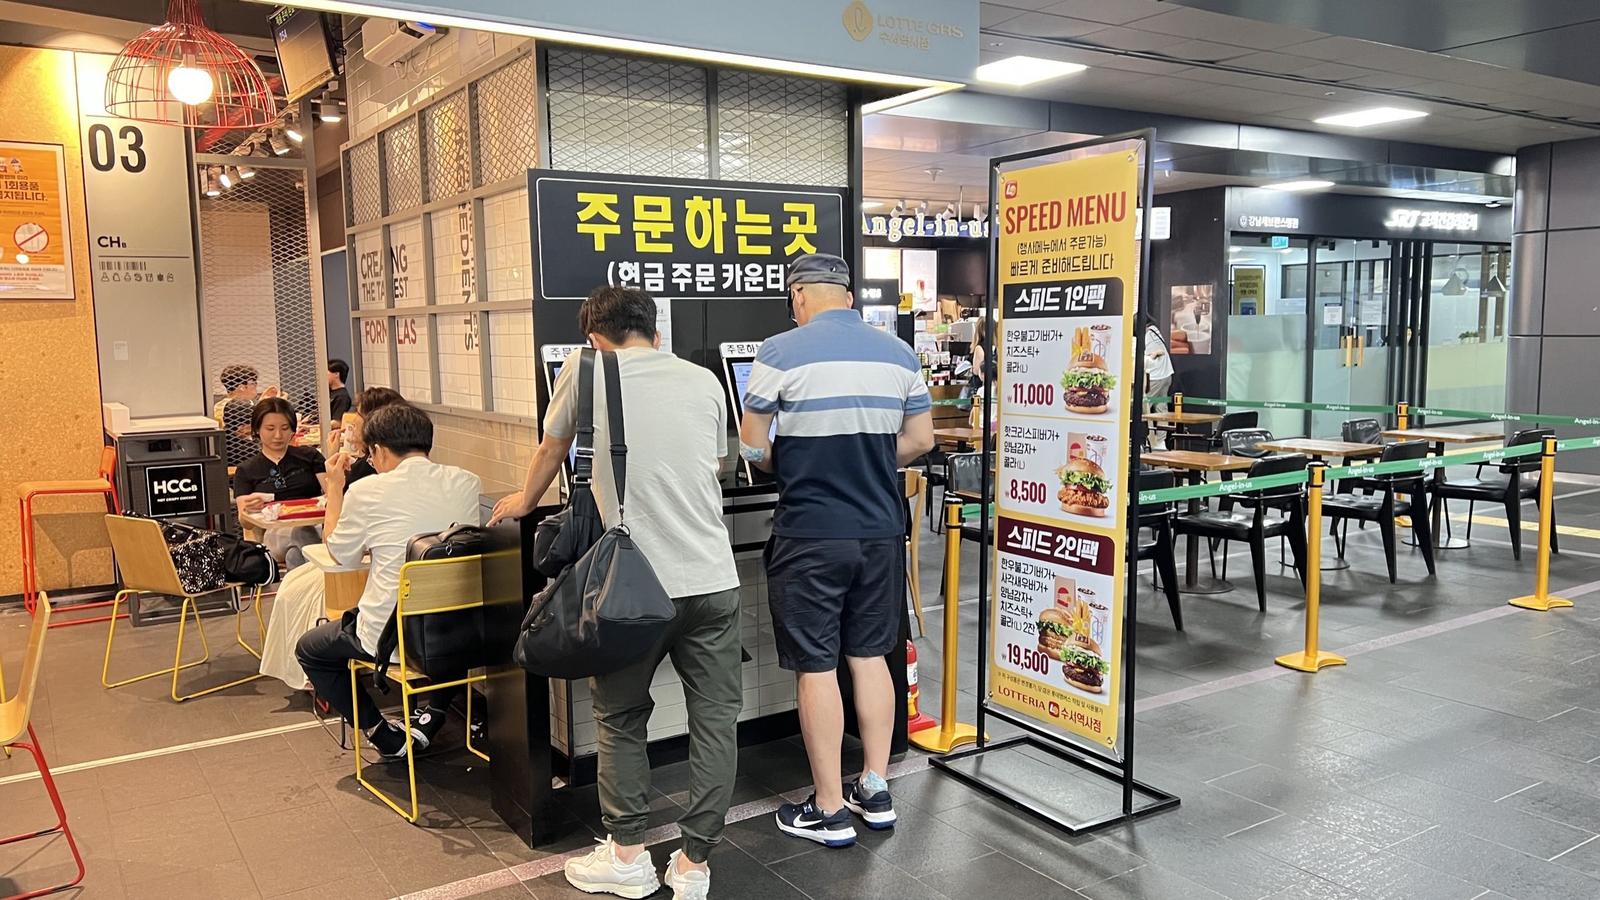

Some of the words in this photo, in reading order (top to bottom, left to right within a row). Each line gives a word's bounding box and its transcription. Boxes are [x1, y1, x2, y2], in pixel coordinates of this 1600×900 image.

[878, 15, 924, 31] LOTTE
[928, 22, 963, 38] GRS
[88, 123, 147, 173] 03
[1005, 200, 1062, 235] SPEED
[1067, 191, 1126, 228] MENU
[1017, 237, 1067, 255] (행사메뉴에서
[1070, 234, 1107, 250] 주문가능)
[1010, 260, 1038, 277] 빠르게
[1042, 253, 1114, 274] 준비해드립니다
[671, 263, 716, 292] 주문
[362, 282, 376, 302] THE
[1014, 285, 1062, 312] 스피드
[1064, 284, 1107, 311] 1인팩
[1007, 329, 1064, 343] 한우불고기버거+
[1006, 345, 1040, 358] 치즈스틱+
[1574, 417, 1600, 425] Angel-in-
[1004, 425, 1060, 442] 핫크리스피버거+
[1219, 482, 1253, 492] Angel-in-us
[1006, 526, 1053, 556] 스피드
[1055, 537, 1100, 566] 2인팩
[1001, 557, 1057, 580] 한우불고기버거+
[1000, 600, 1033, 619] 치즈스틱+
[998, 685, 1046, 712] LOTTERIA
[1061, 708, 1102, 733] 수서역사점
